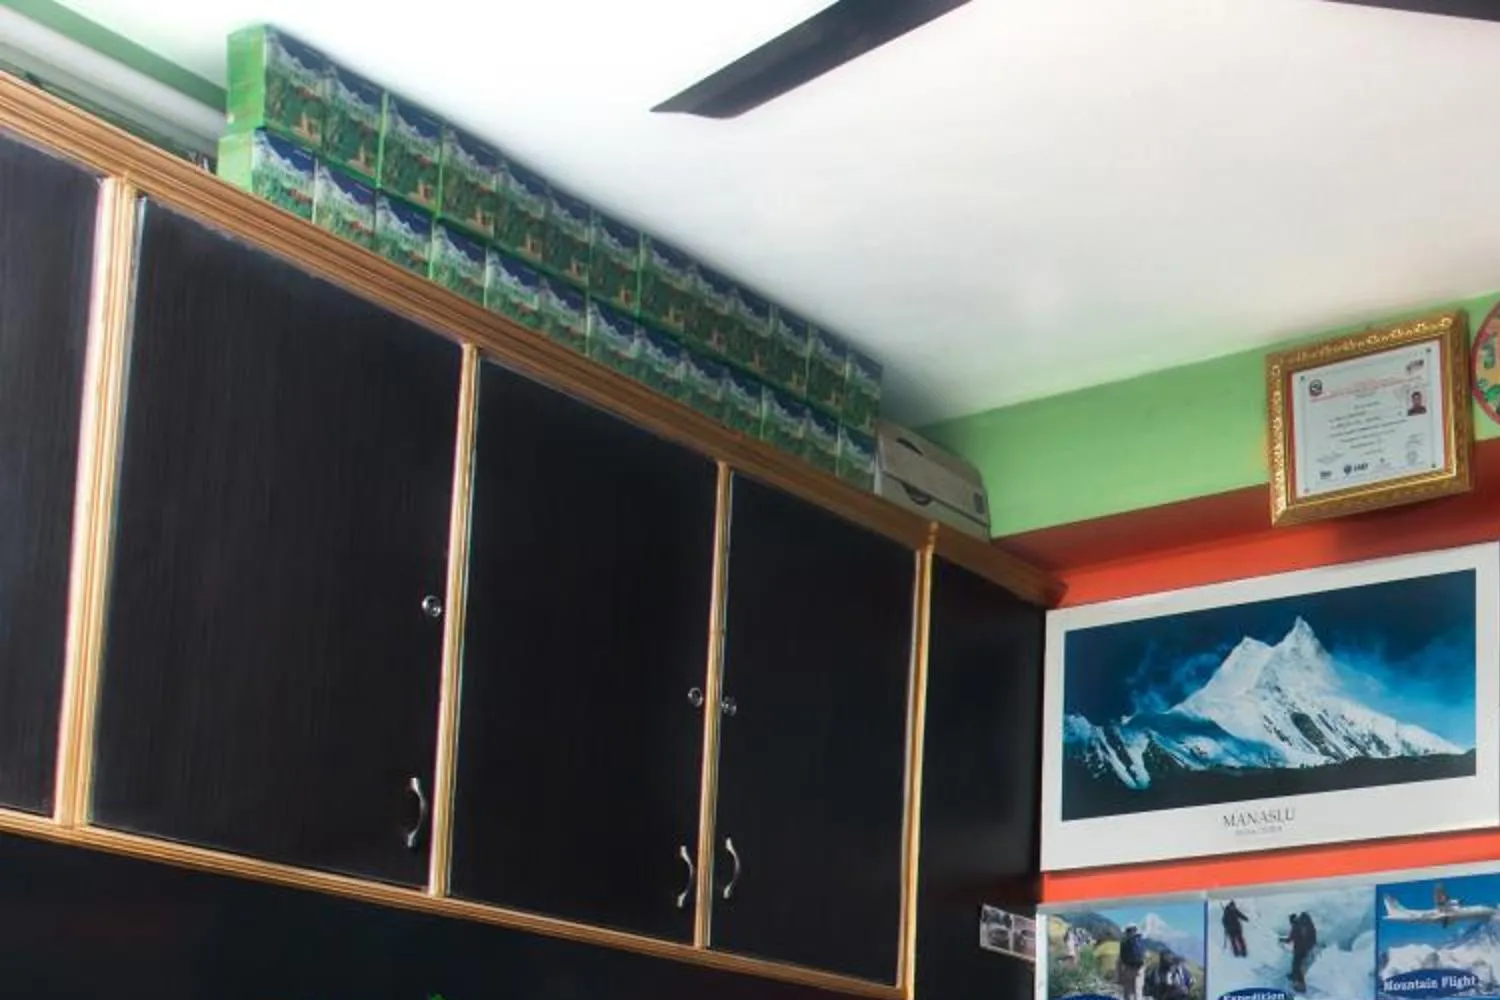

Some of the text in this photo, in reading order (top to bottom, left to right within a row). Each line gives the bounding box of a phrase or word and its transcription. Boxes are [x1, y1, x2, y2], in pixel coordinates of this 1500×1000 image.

[1223, 807, 1296, 827] MANASLU
[1383, 974, 1477, 992] Mountain Flight
